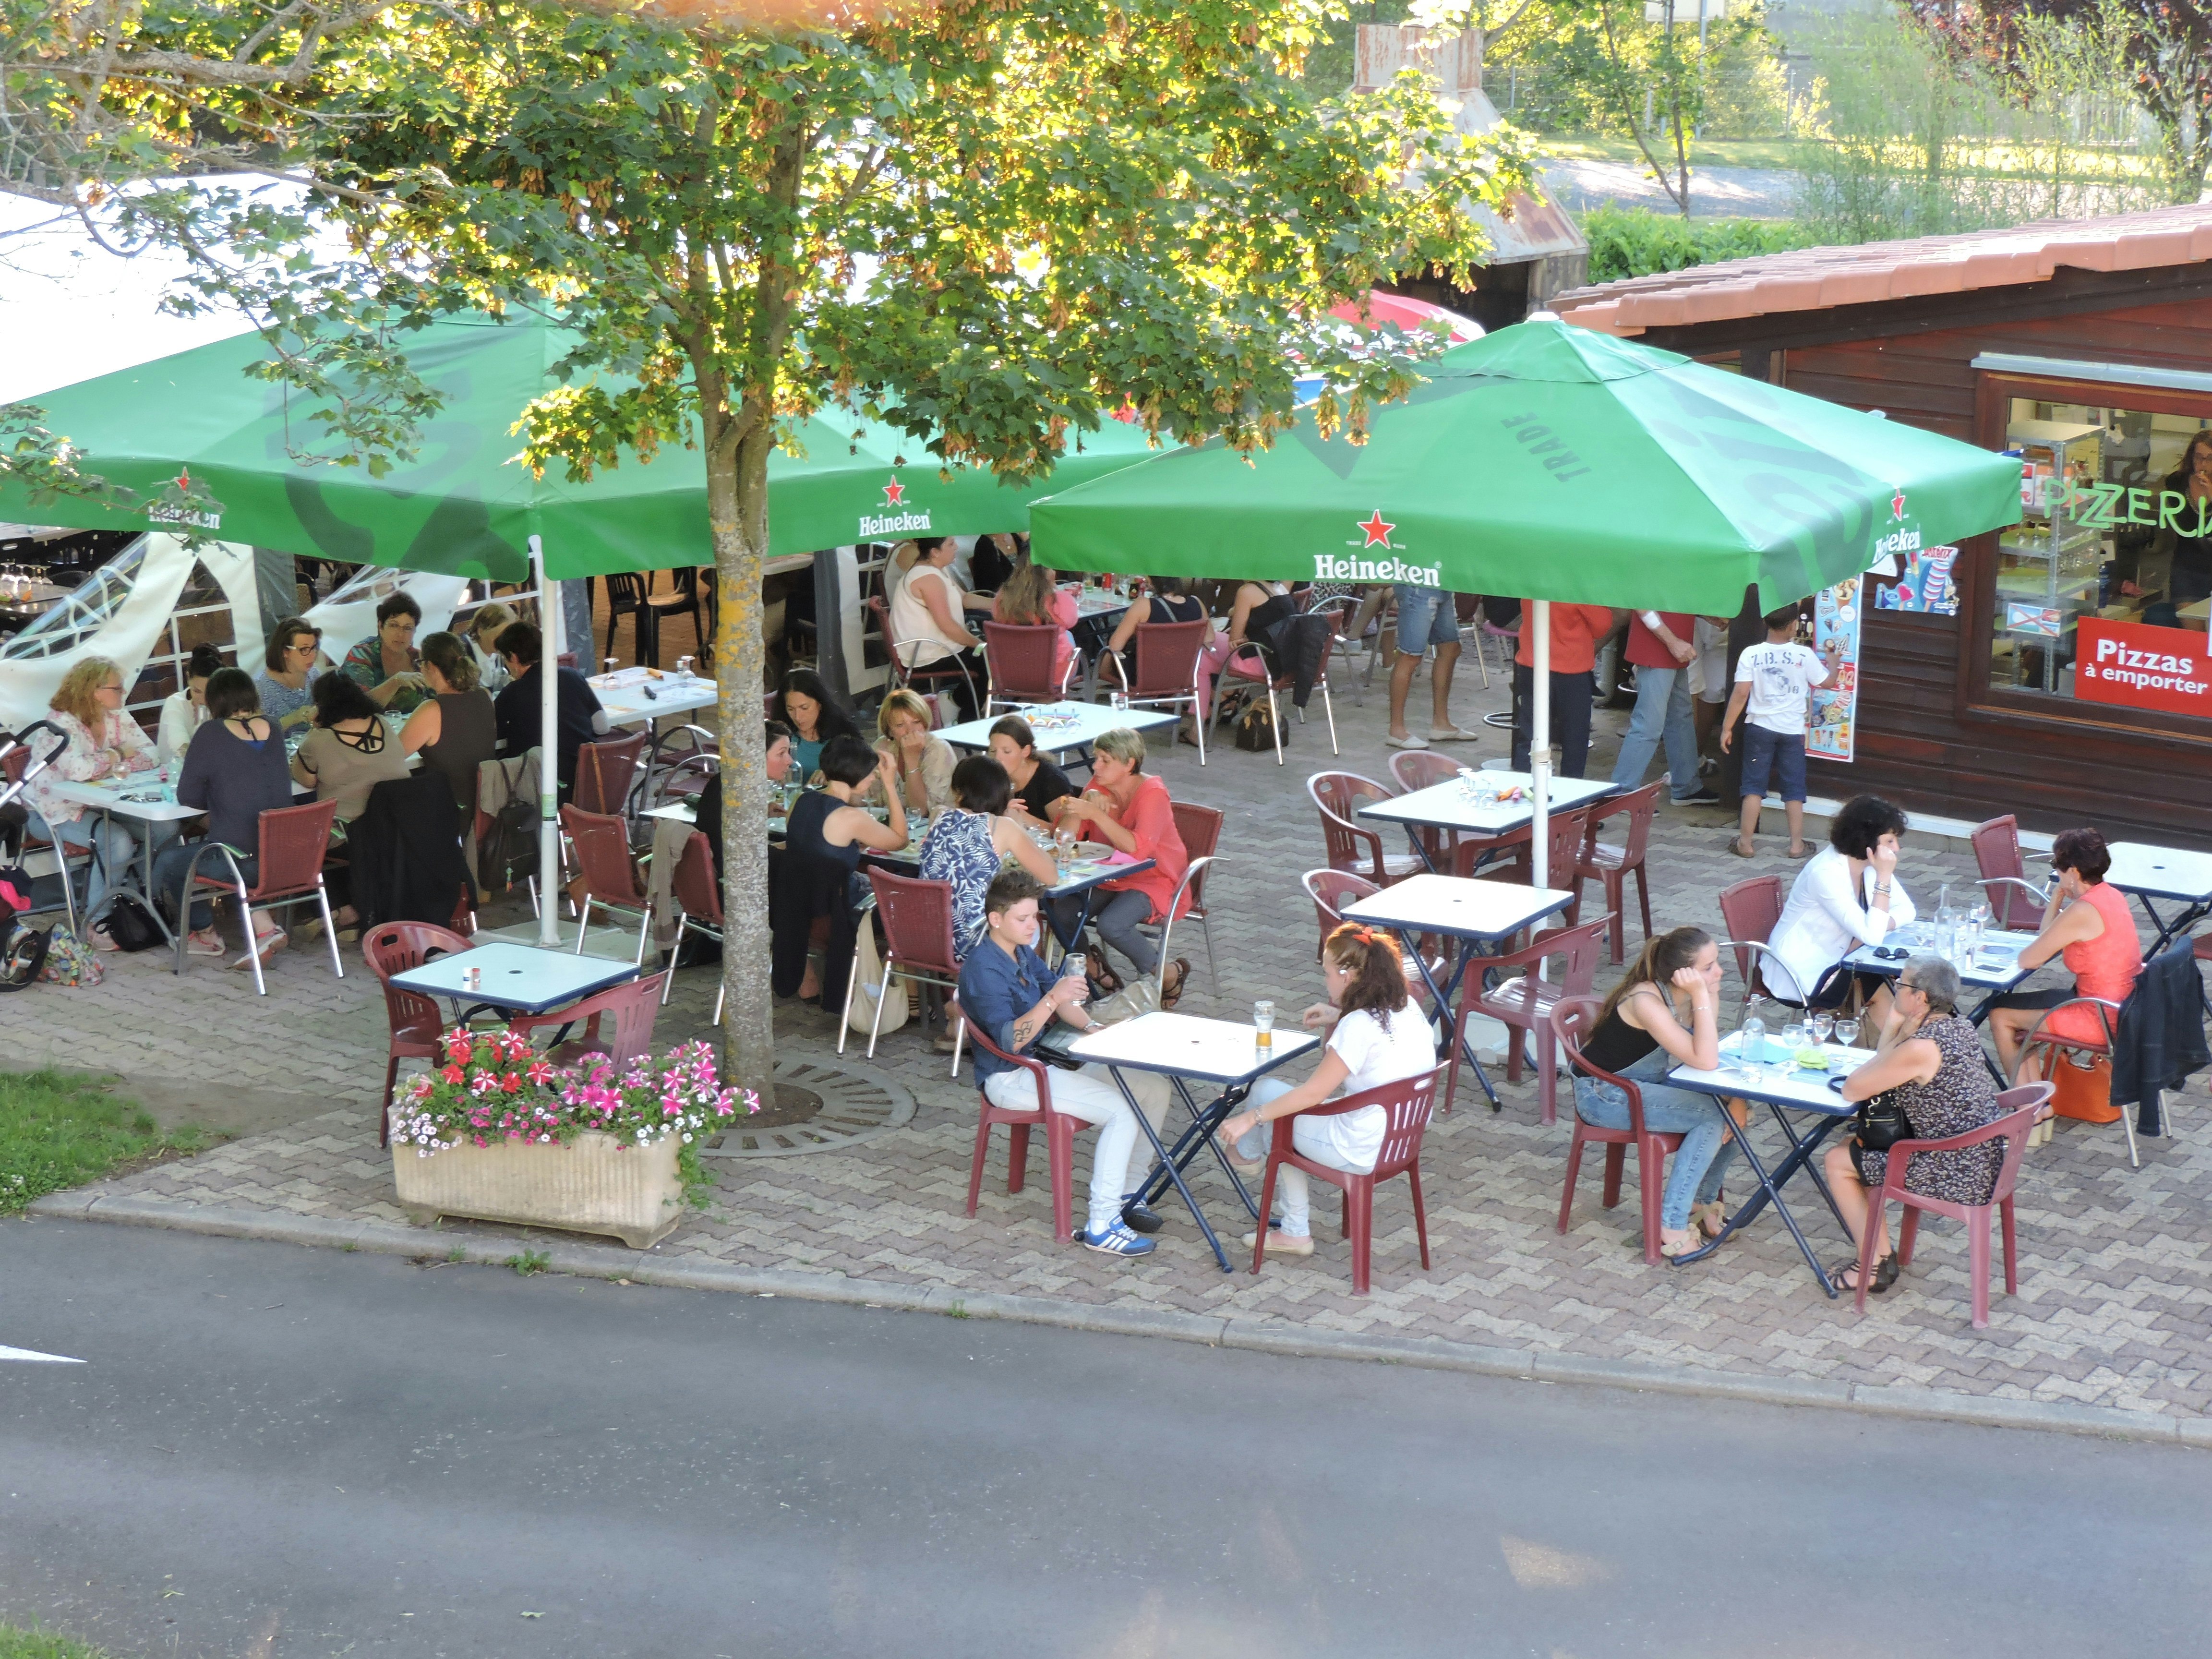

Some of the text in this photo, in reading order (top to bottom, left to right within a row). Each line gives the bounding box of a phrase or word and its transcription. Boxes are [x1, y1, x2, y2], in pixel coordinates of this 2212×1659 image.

[1501, 411, 1592, 483] TRADE
[859, 511, 931, 537] Heineken
[2044, 478, 2212, 538] PIZZERI
[1313, 554, 1441, 587] Heineken
[2096, 638, 2193, 674] Pizzas
[2085, 662, 2208, 695] à emporter
